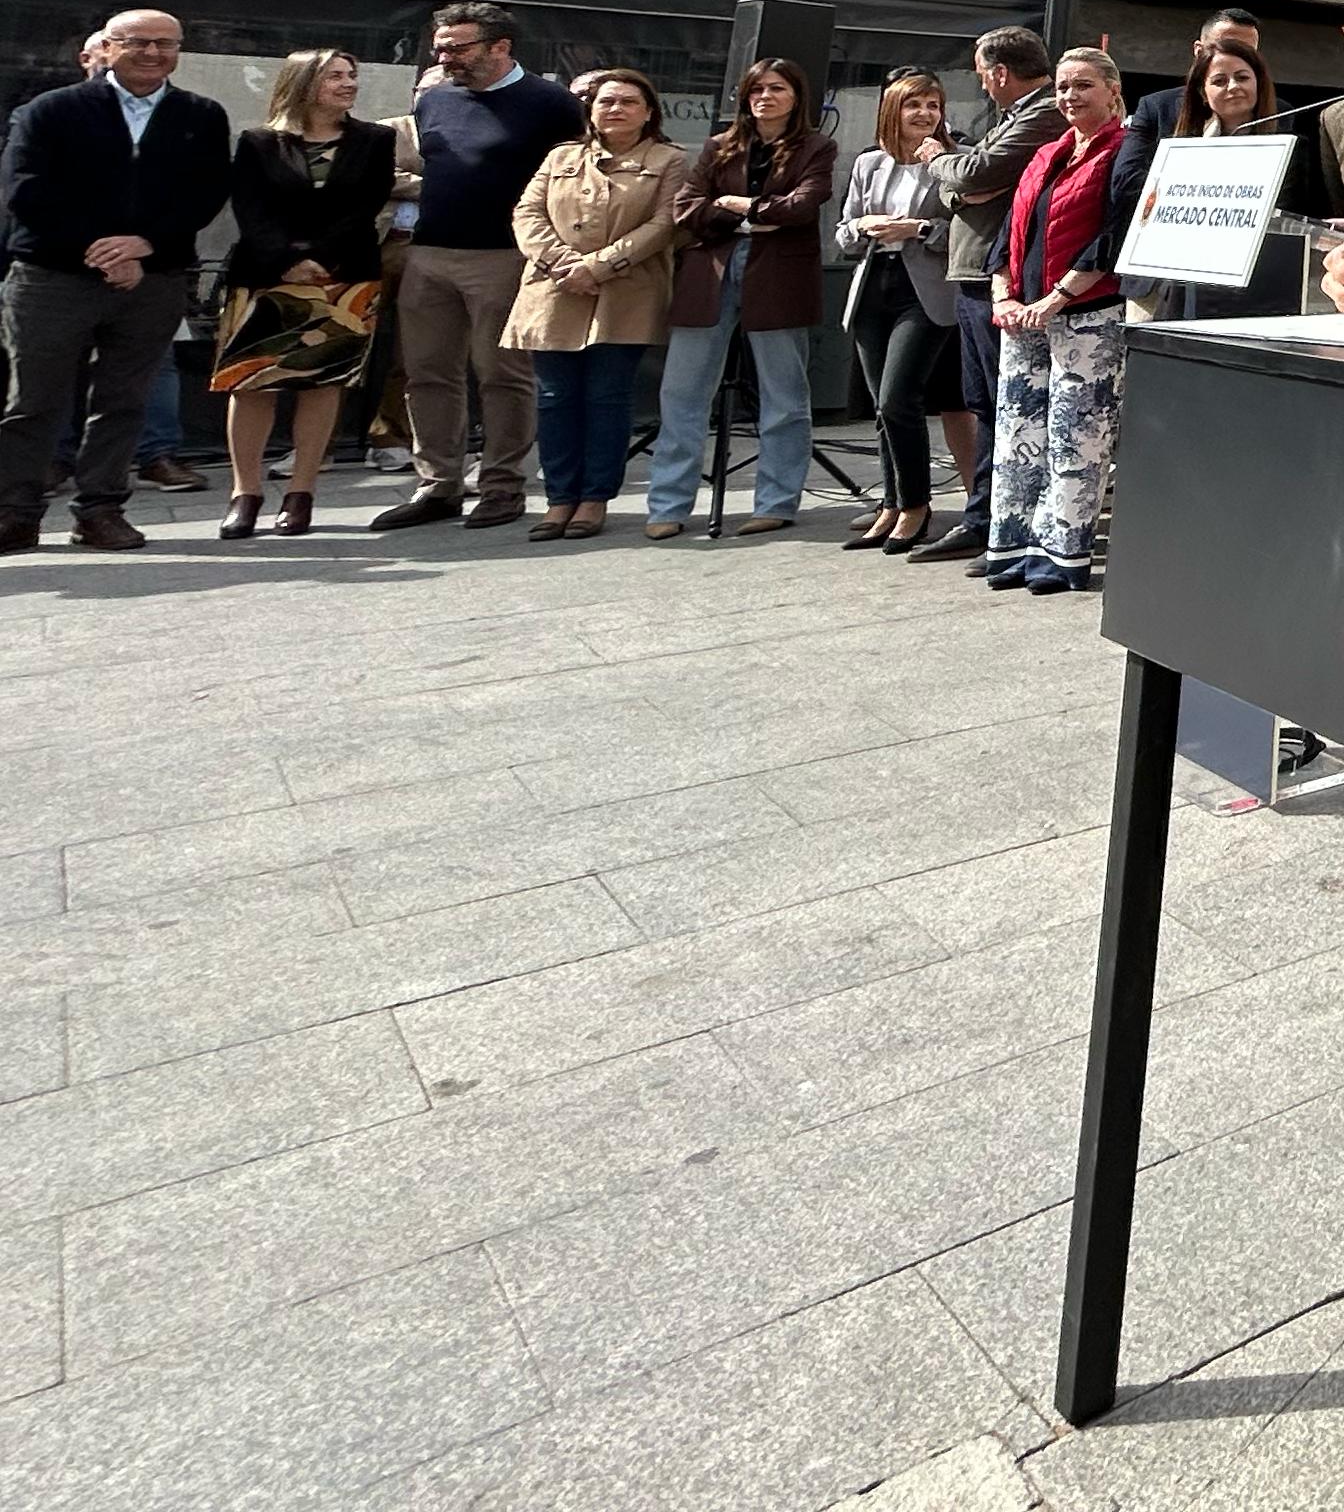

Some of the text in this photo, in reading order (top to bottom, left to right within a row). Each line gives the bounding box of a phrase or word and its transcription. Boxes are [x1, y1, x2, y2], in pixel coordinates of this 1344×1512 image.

[1165, 184, 1264, 199] ACTO DE INICIO DE OBRAS
[1153, 206, 1259, 229] MERCADO CENTRAL
